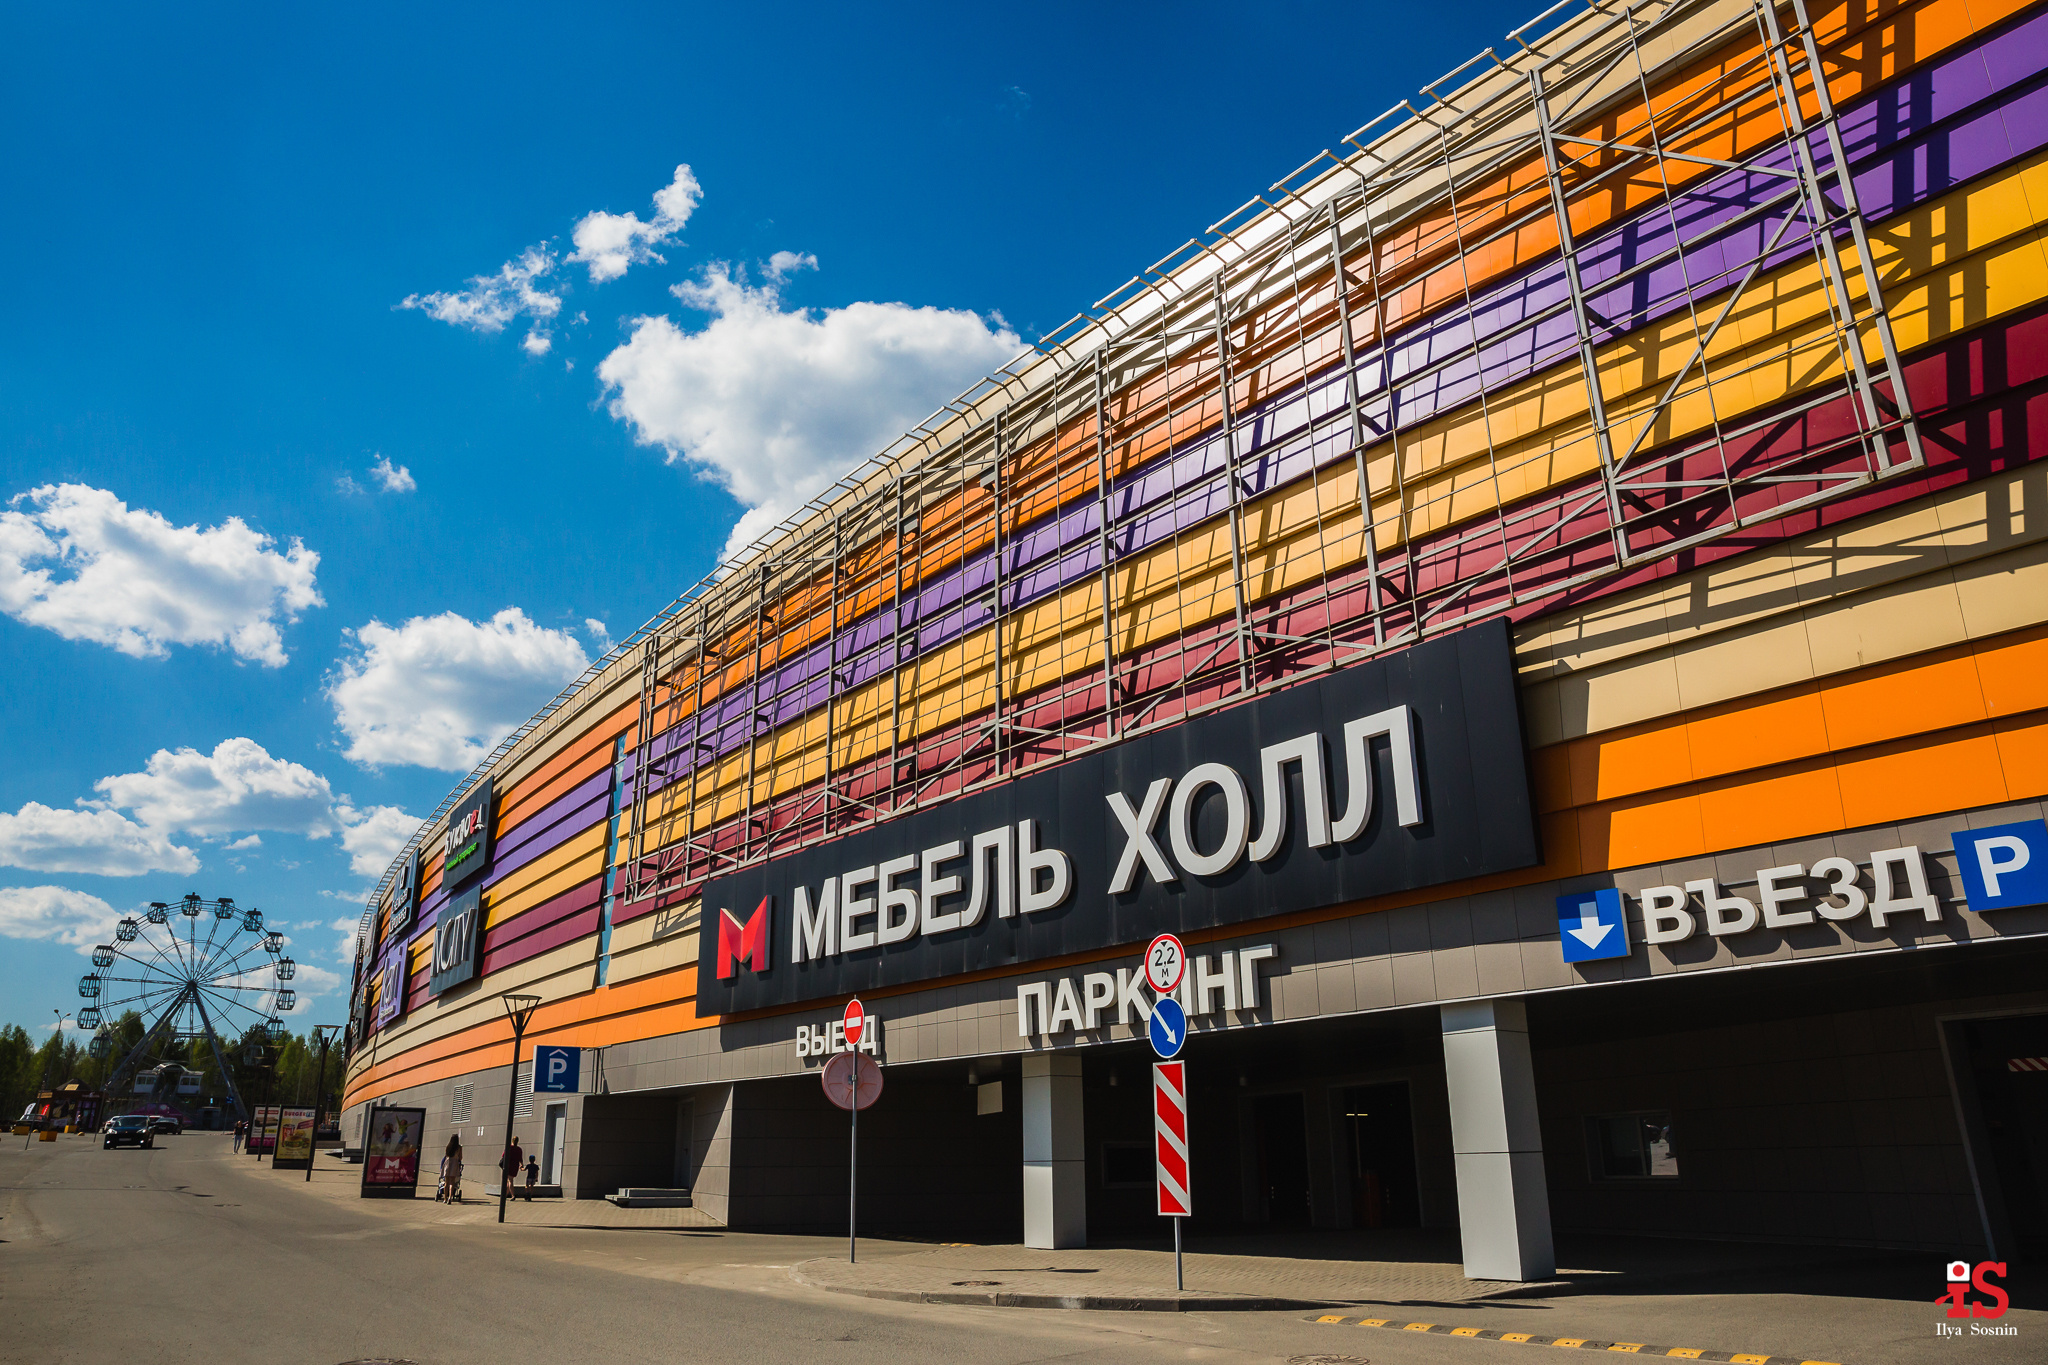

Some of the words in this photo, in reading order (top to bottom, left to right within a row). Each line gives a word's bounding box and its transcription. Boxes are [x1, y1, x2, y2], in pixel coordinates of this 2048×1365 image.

[791, 818, 1072, 964] МЕБЕЛЬ
[1105, 704, 1425, 895] ХОЛЛ
[1972, 835, 2031, 898] P
[1639, 845, 1944, 946] ВЪЕЗД
[1154, 946, 1176, 967] 2,2
[796, 1014, 882, 1058] ВЫЕД
[547, 1057, 568, 1083] P
